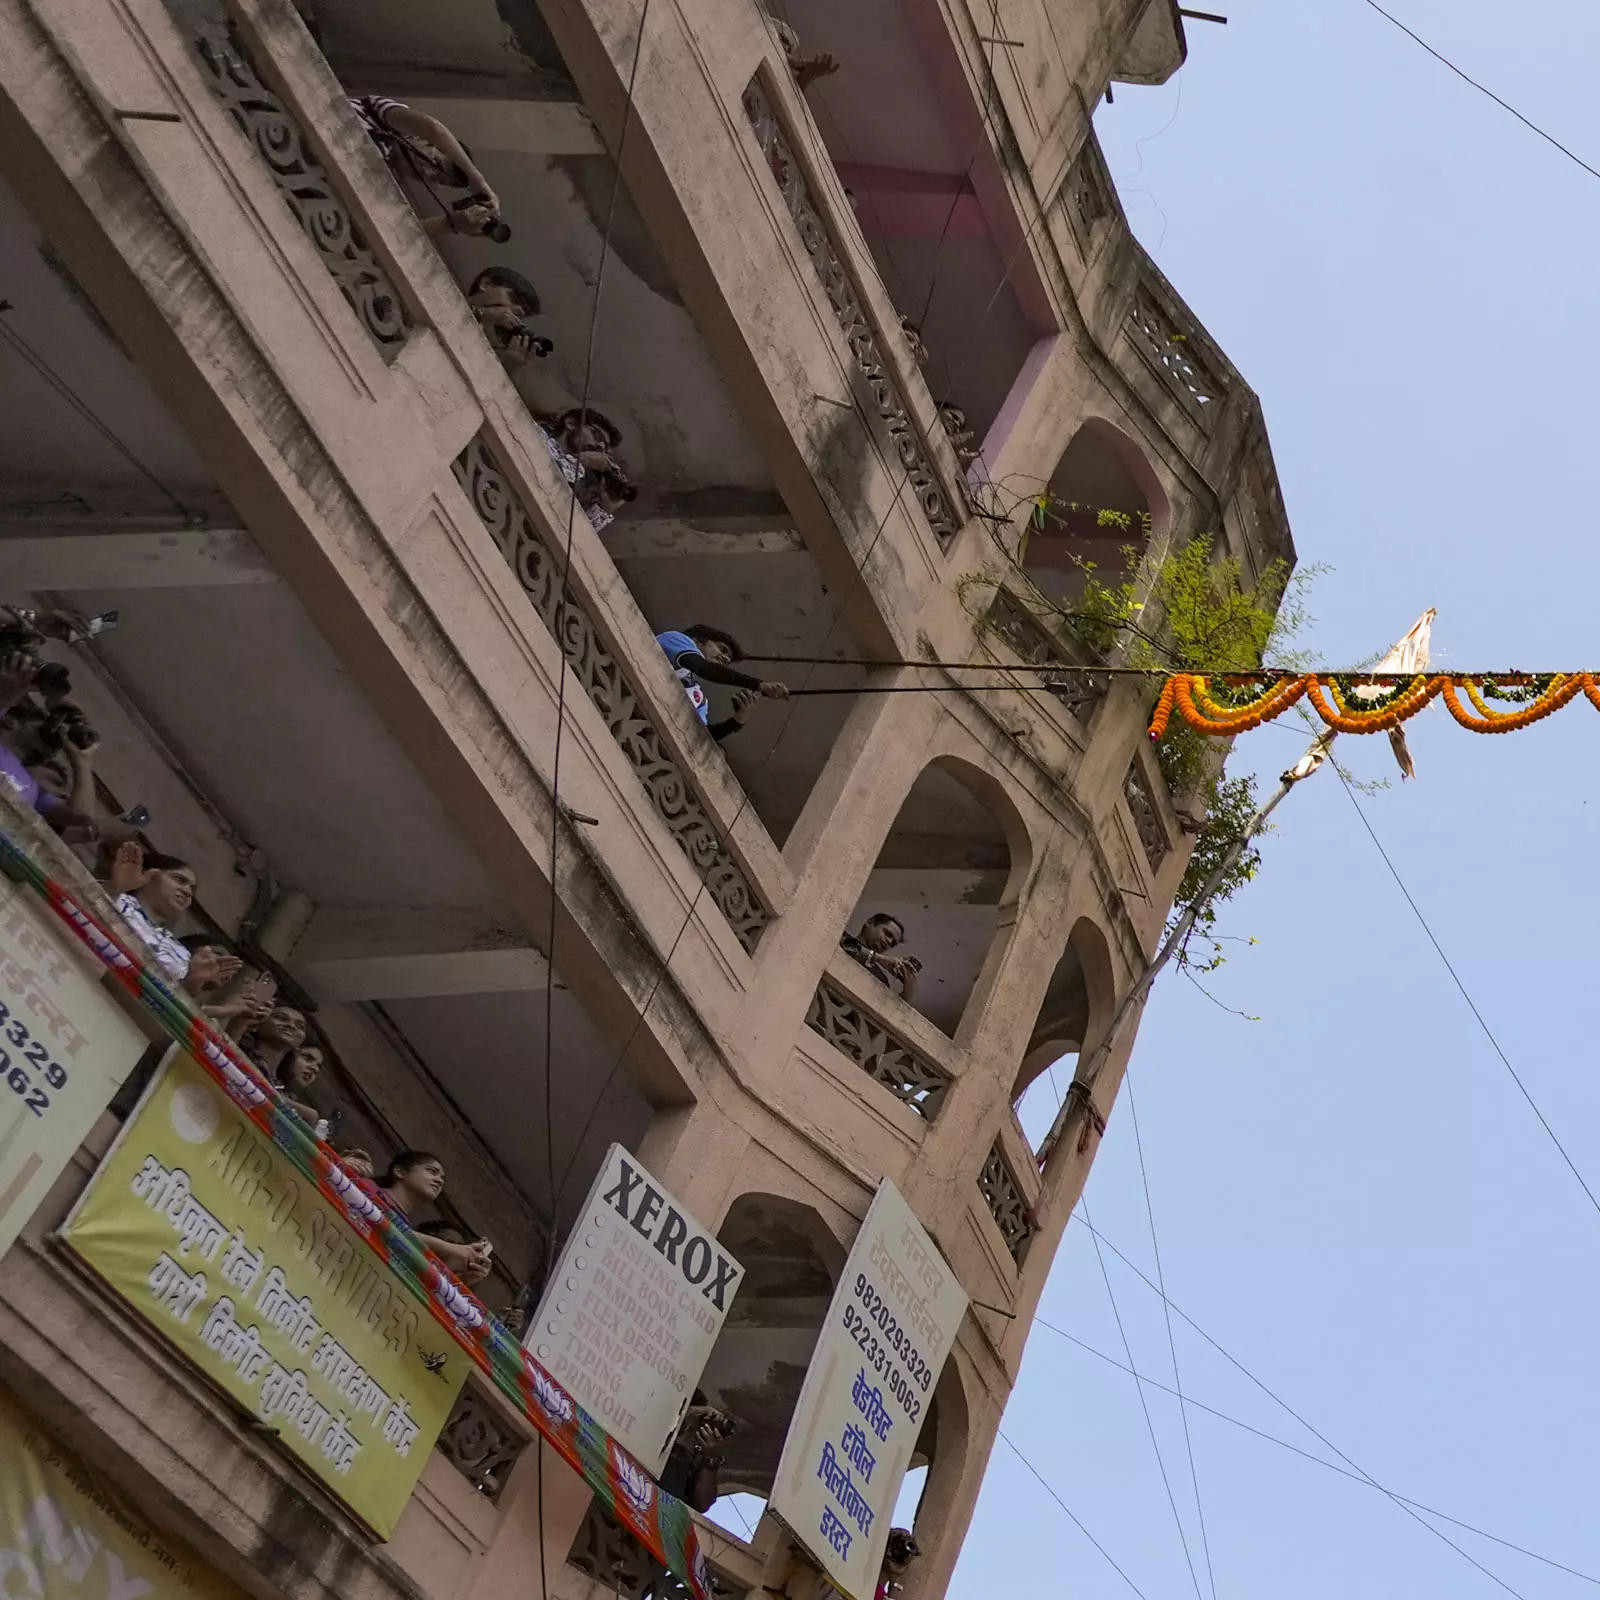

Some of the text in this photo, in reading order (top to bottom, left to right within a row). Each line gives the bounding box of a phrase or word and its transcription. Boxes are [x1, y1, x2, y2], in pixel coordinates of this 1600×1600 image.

[602, 1158, 738, 1312] XEROX
[612, 1225, 715, 1335] VISITING CARD
[131, 1154, 421, 1457] अधिकृत रेल्वे तिकीट आरक्षण केंद्र
[584, 1291, 689, 1393] FLEX DESIGNS
[593, 1267, 682, 1359] PAMPHLATE
[600, 1246, 681, 1332] BILL BOOK
[854, 1273, 933, 1393] 9820293329
[148, 1251, 363, 1476] यात्री टिकीट सुविधा केंद्र
[554, 1353, 636, 1434] PRINTOUT
[565, 1332, 622, 1395] TYPING
[573, 1311, 634, 1374] STANDY
[842, 1304, 922, 1425] 9223319062
